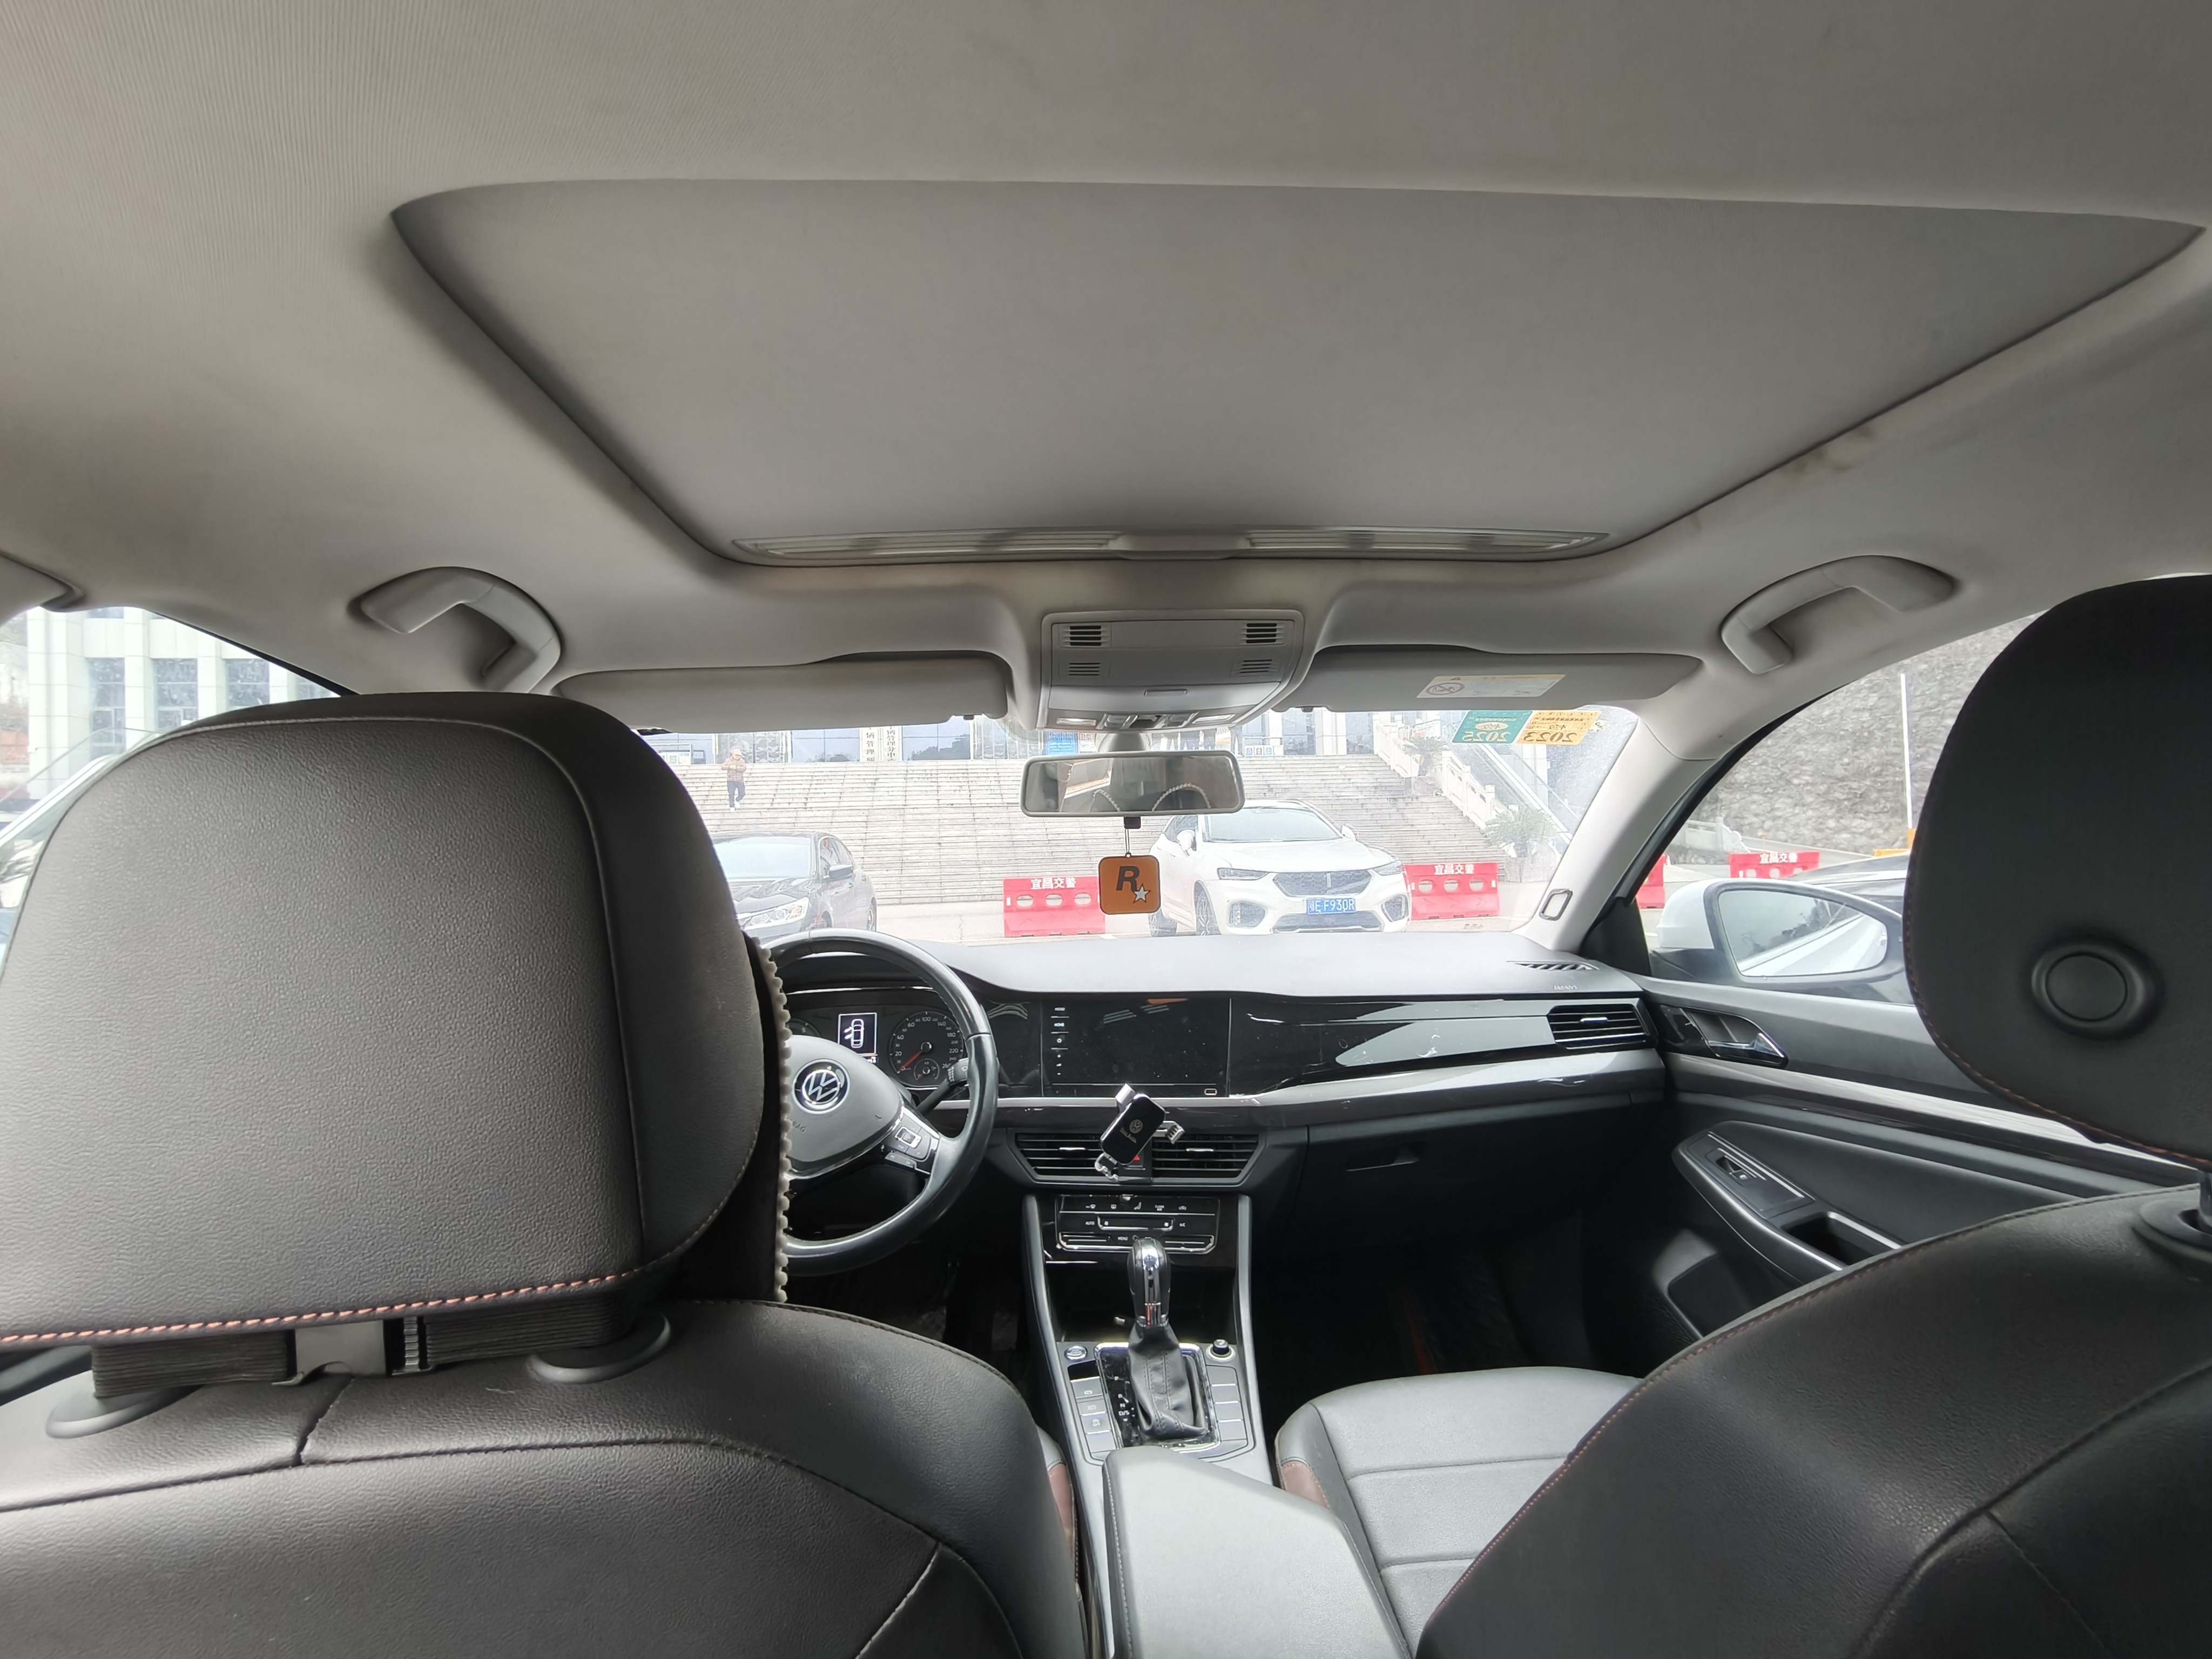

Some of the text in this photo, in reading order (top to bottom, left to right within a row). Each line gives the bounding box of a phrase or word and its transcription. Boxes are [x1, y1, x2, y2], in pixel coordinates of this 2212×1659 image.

[1759, 852, 1798, 864] 宜昌交警
[1434, 864, 1475, 875] 宜昌交警
[1031, 876, 1076, 890] 宜昌交警
